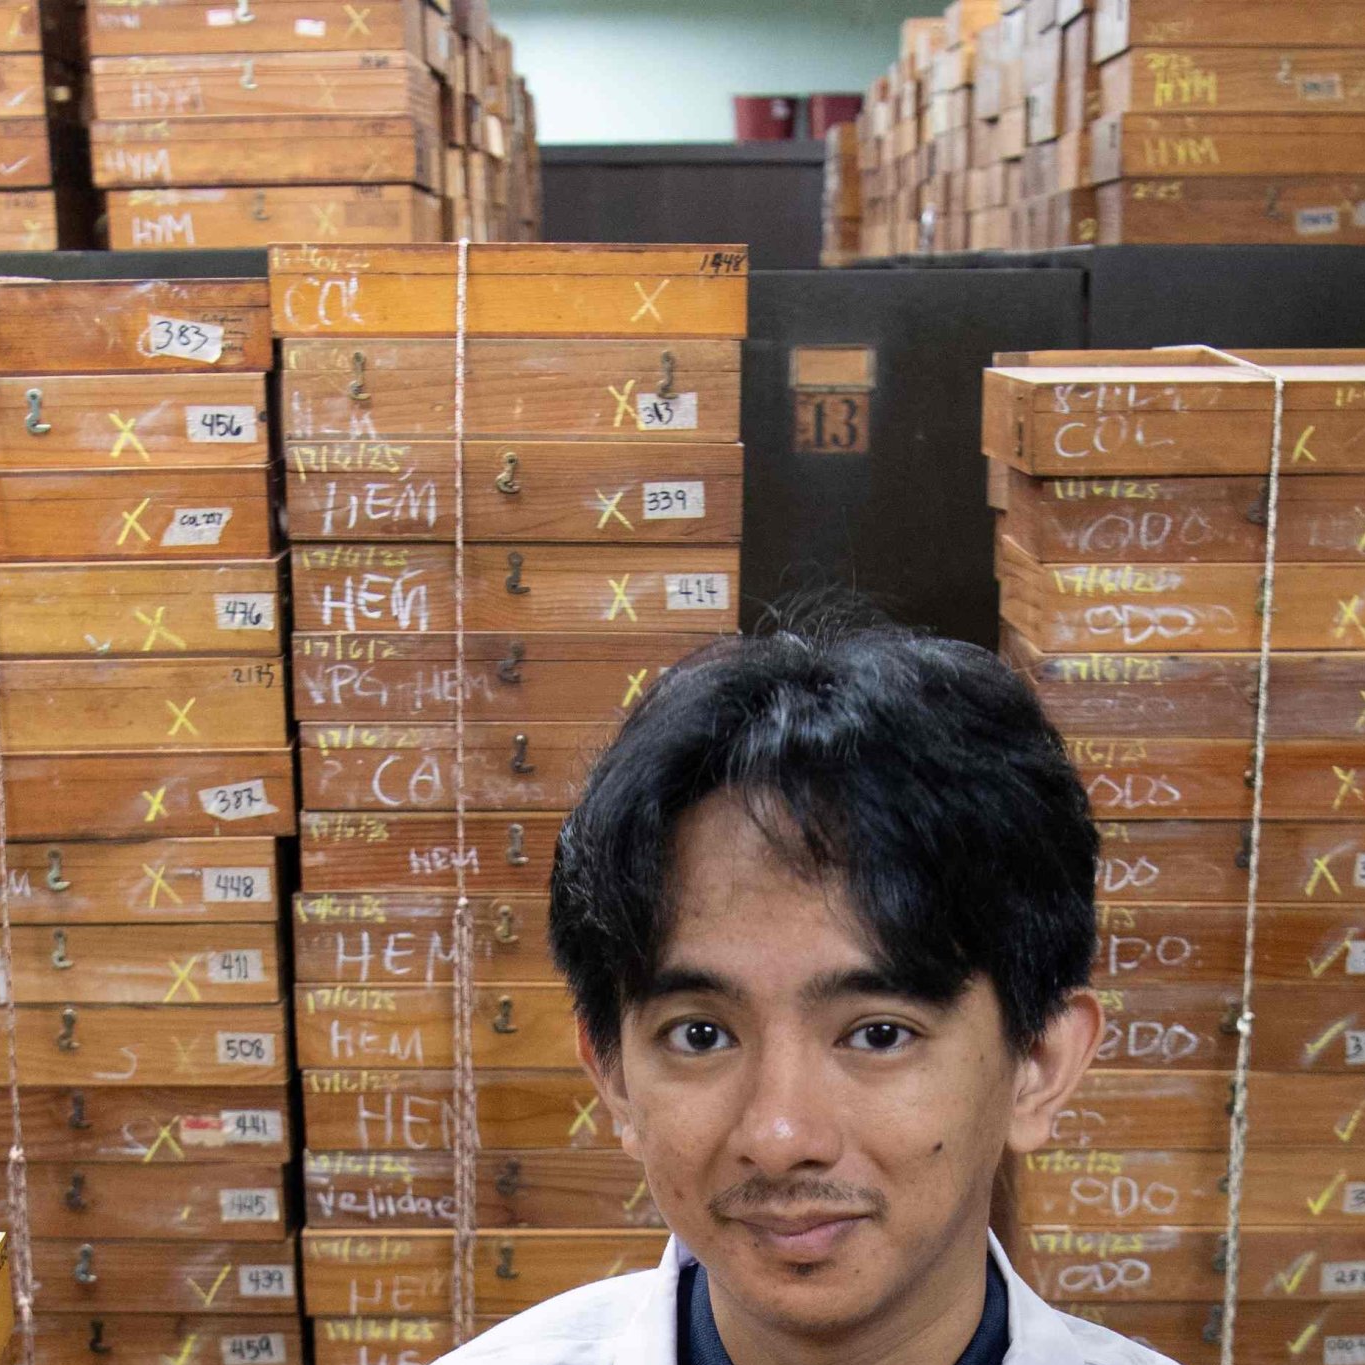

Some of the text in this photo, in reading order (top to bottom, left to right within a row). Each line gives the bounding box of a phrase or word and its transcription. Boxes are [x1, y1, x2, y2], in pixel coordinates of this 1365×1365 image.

[1154, 70, 1219, 109] HYM
[102, 148, 173, 181] HYM
[131, 211, 197, 246] HYM
[155, 319, 210, 353] 383
[201, 412, 244, 438] 456
[813, 398, 859, 448] 13
[1054, 414, 1176, 459] COL
[646, 489, 688, 512] 339
[677, 577, 719, 606] 414
[1083, 603, 1197, 645] ODO
[409, 846, 481, 875] HEM
[1095, 857, 1160, 893] DO
[335, 929, 463, 986] HEM
[1097, 933, 1192, 976] DO
[224, 1037, 266, 1061] 508
[329, 1019, 425, 1065] HEM
[1069, 1176, 1180, 1217] ODO
[1058, 1258, 1151, 1294] ODO
